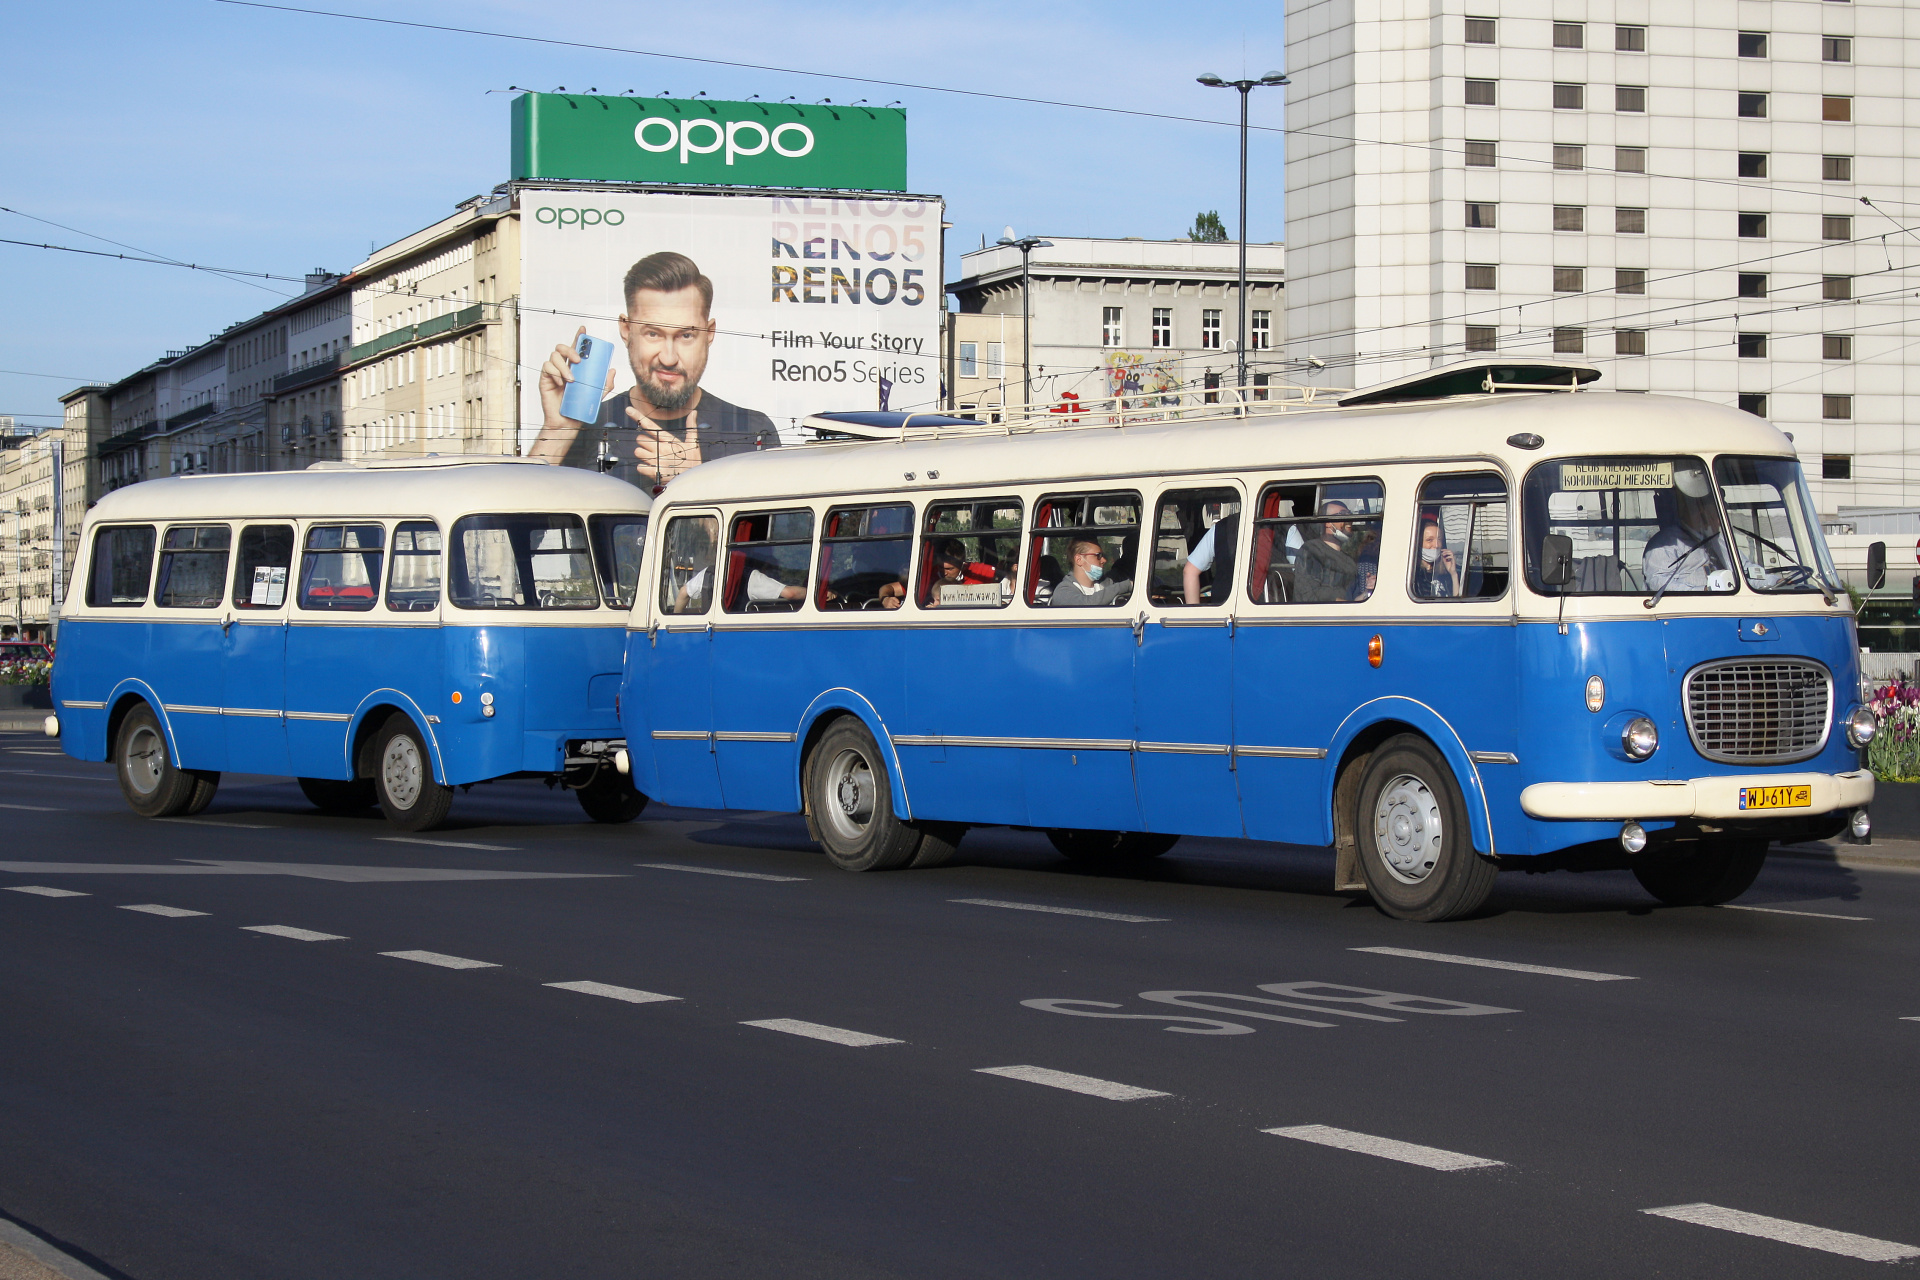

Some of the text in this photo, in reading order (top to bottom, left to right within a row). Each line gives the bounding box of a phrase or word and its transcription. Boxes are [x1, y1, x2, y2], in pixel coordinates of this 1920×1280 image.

[634, 117, 814, 165] oppo
[535, 207, 625, 230] oppo
[771, 221, 925, 262] RENO5
[771, 265, 925, 306] RENO5
[771, 330, 924, 355] Film Your Story
[771, 359, 925, 383] Reno5 Series
[1564, 474, 1670, 486] KOMUNIKACJI MIEJSKIEJ
[1748, 788, 1793, 806] WJ 61Y
[1019, 981, 1524, 1035] BUS
